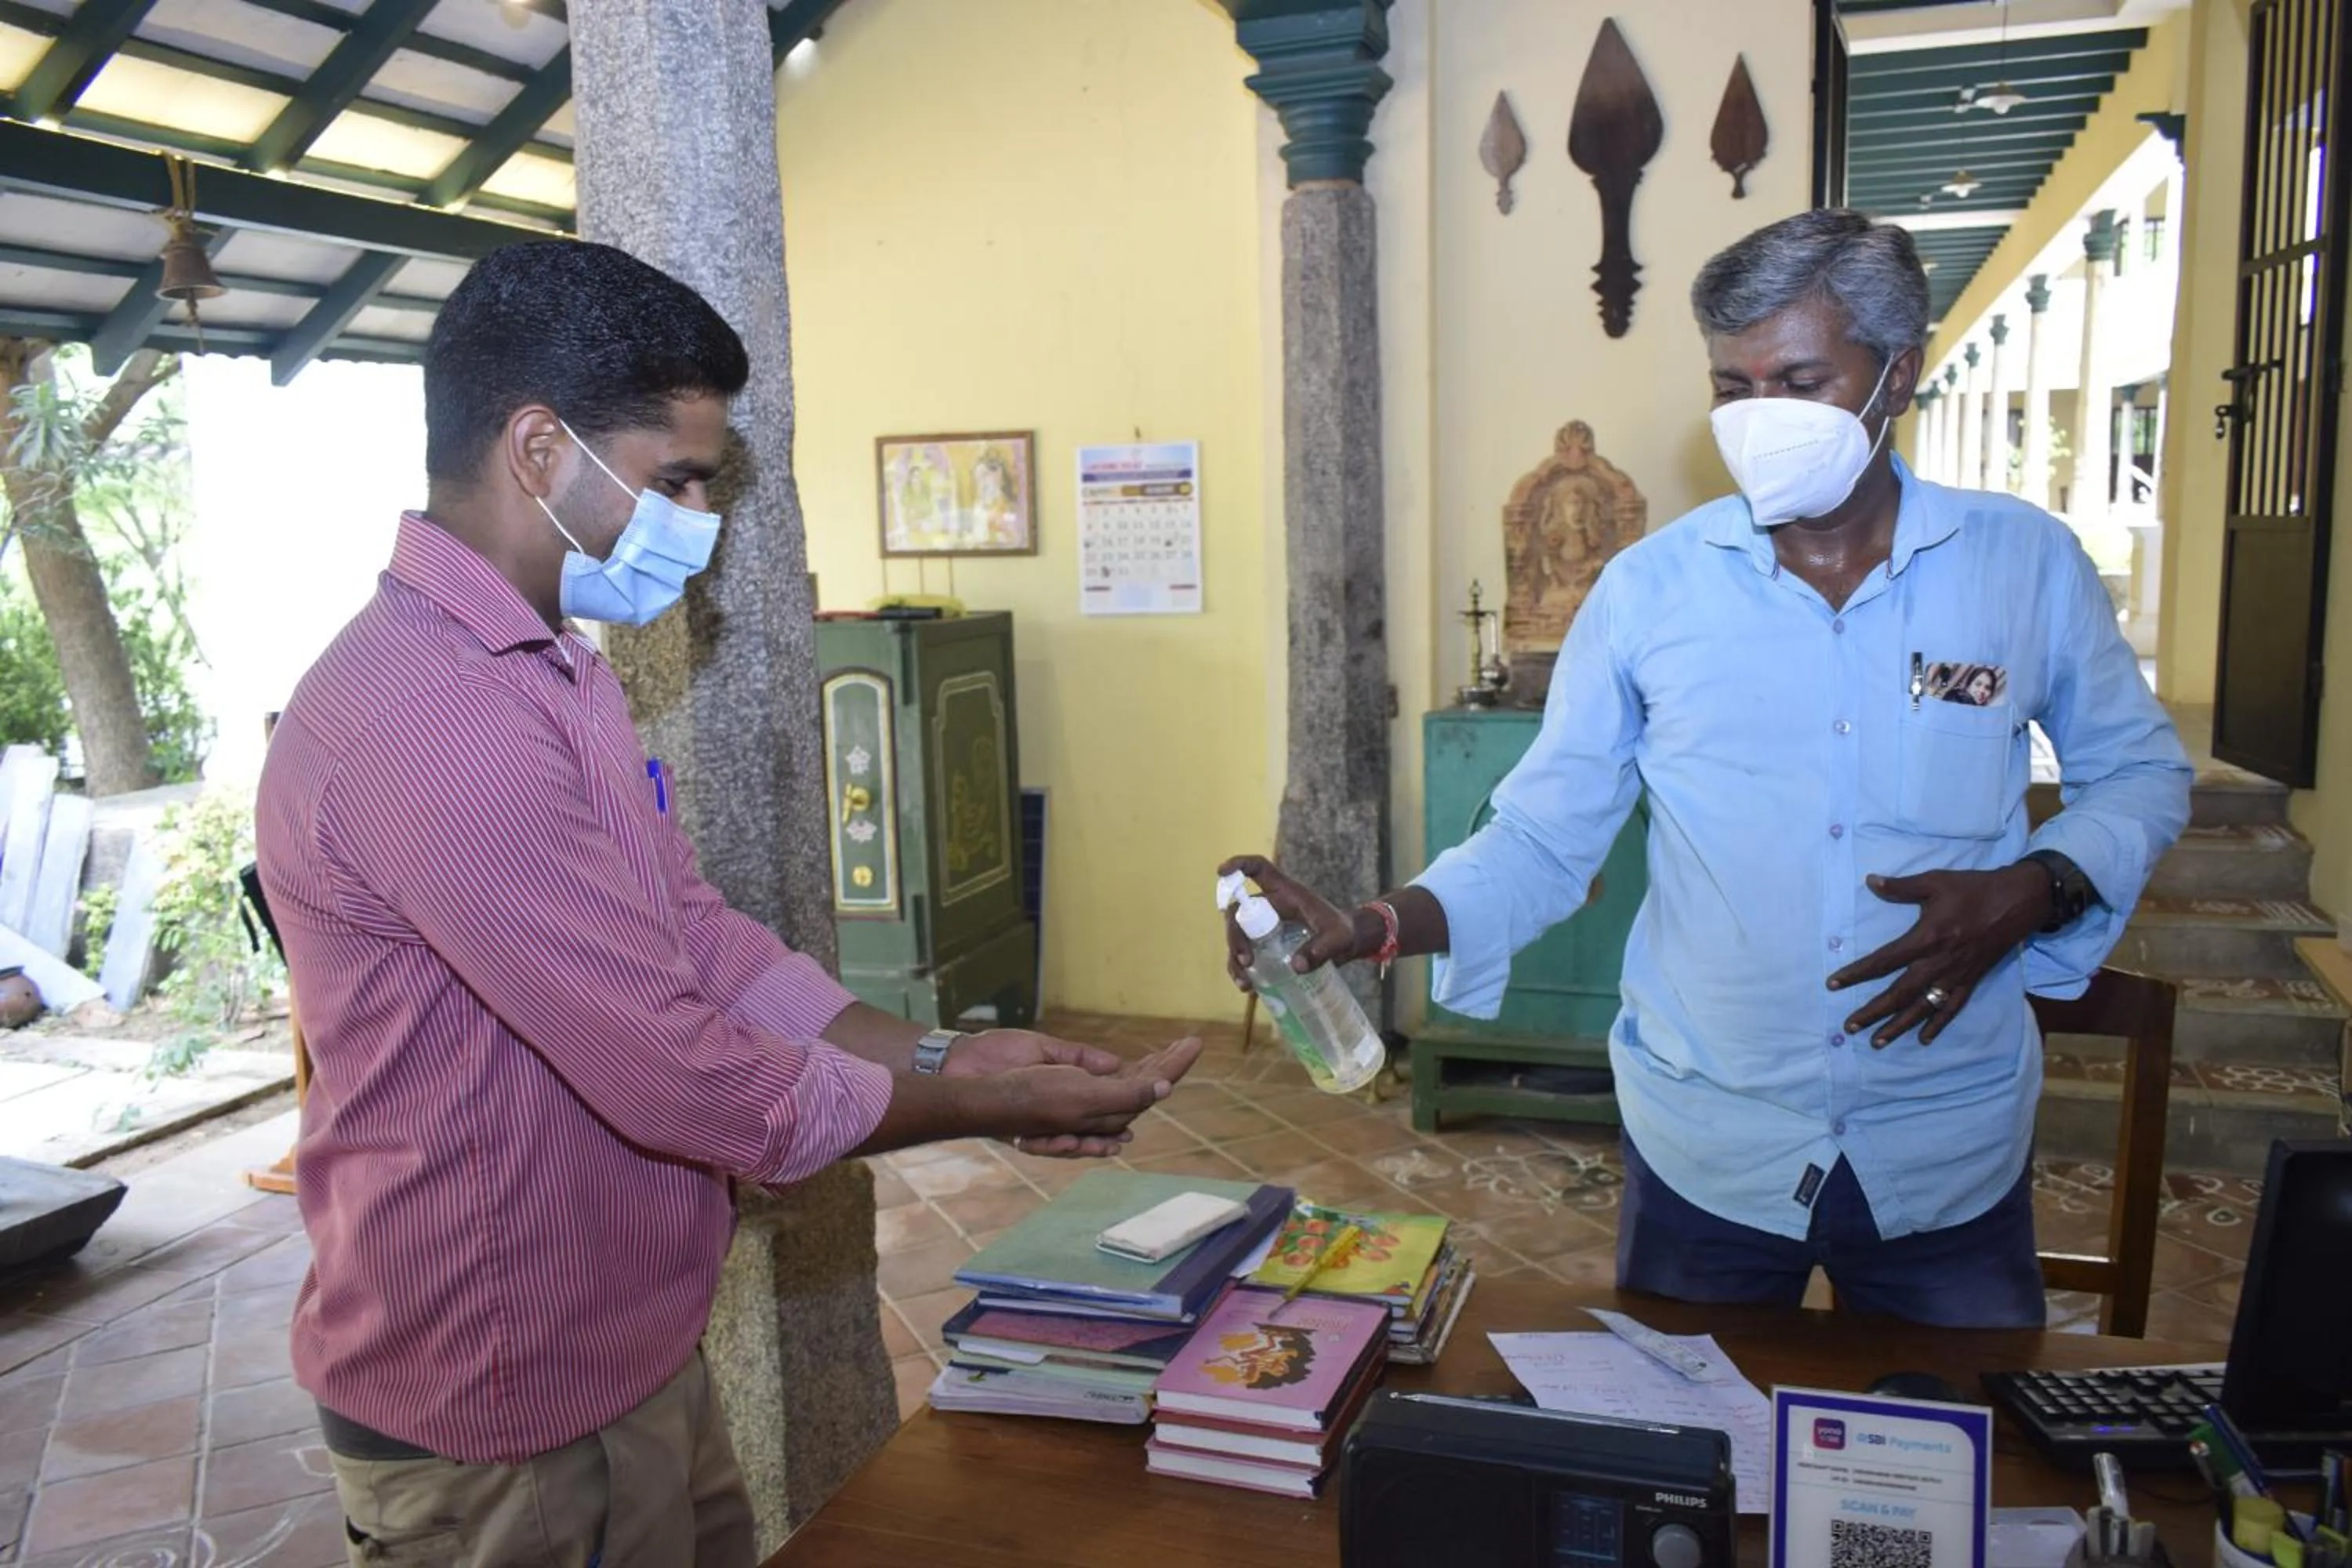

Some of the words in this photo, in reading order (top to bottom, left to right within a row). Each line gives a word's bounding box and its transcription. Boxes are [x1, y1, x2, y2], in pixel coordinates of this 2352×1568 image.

[1867, 1434, 1886, 1446] SBI
[1889, 1436, 1952, 1454] Payments
[1655, 1492, 1707, 1508] PHILIPS
[1840, 1498, 1878, 1515] SCAN
[1892, 1506, 1917, 1518] PAY
